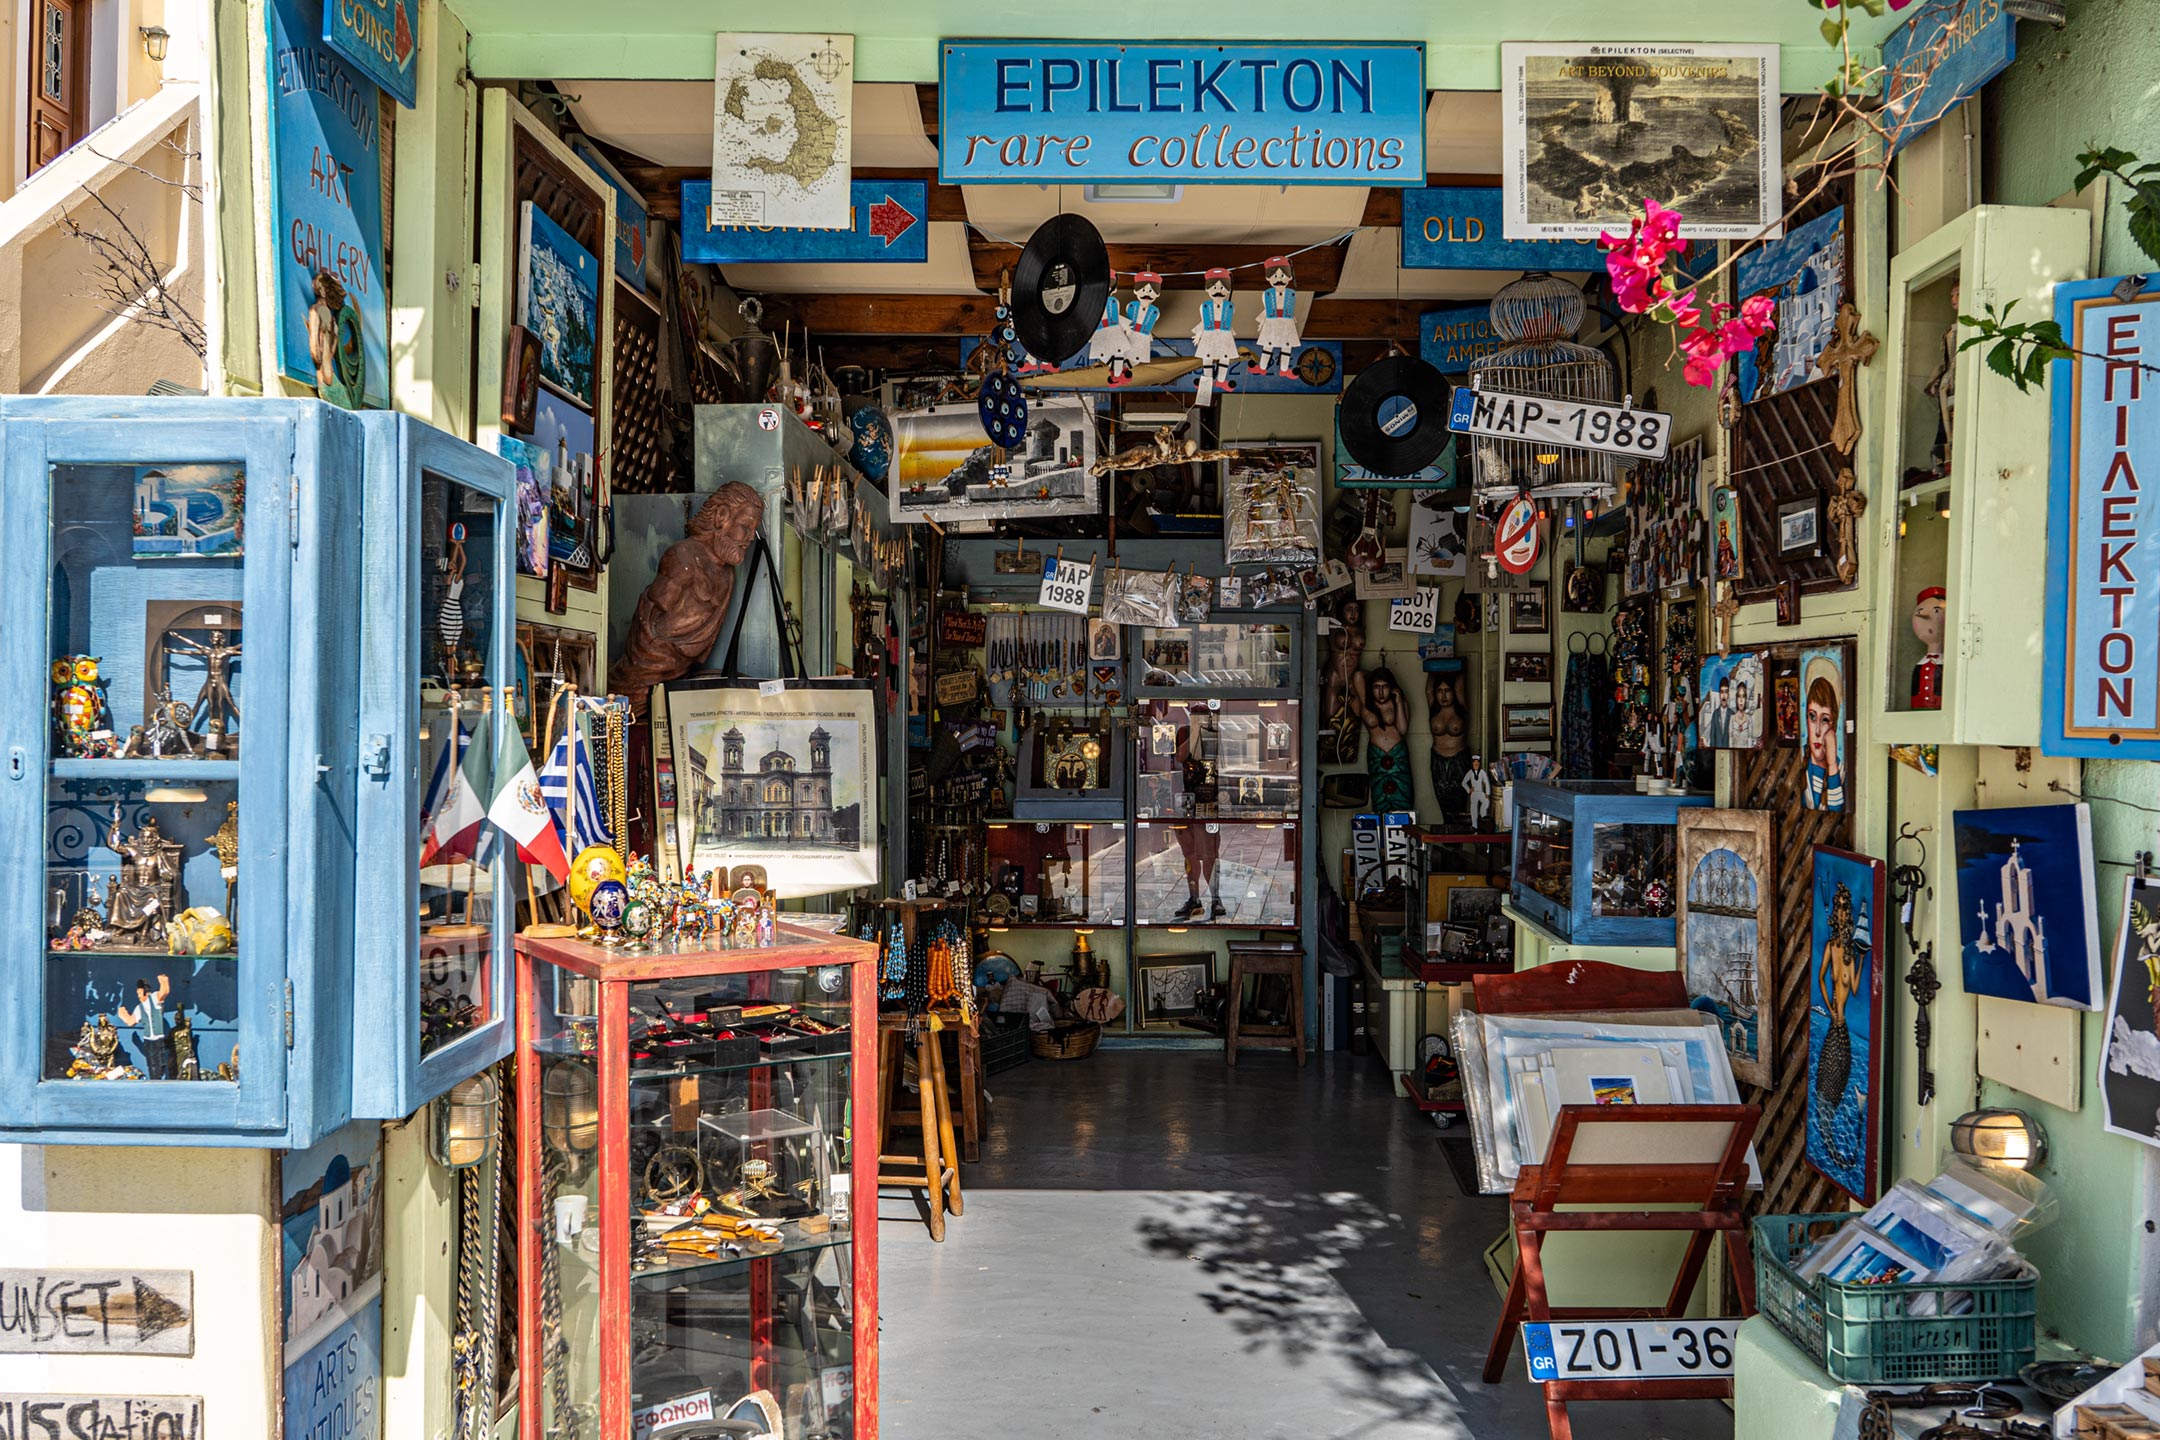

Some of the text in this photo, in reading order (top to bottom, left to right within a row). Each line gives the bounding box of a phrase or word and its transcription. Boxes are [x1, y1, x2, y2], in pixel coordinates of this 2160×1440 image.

[1558, 64, 1728, 79] ART BEYOND SOUVENIRS
[1601, 47, 1657, 55] EPILEKTON
[994, 58, 1375, 114] EPILEKTON
[963, 123, 1406, 171] rare collections
[310, 146, 354, 209] ART
[1423, 216, 1485, 243] OLD
[291, 218, 371, 295] GALLERY
[1453, 395, 1661, 450] GR MAP-1988
[2098, 313, 2141, 719] ΕΠΙΛΕΚΤΟΝ
[1046, 584, 1085, 606] 1988
[1055, 566, 1089, 586] MAP
[1393, 610, 1433, 628] 2026
[313, 1331, 358, 1408] ARTS
[1533, 1327, 1736, 1372] GR ZOI-36
